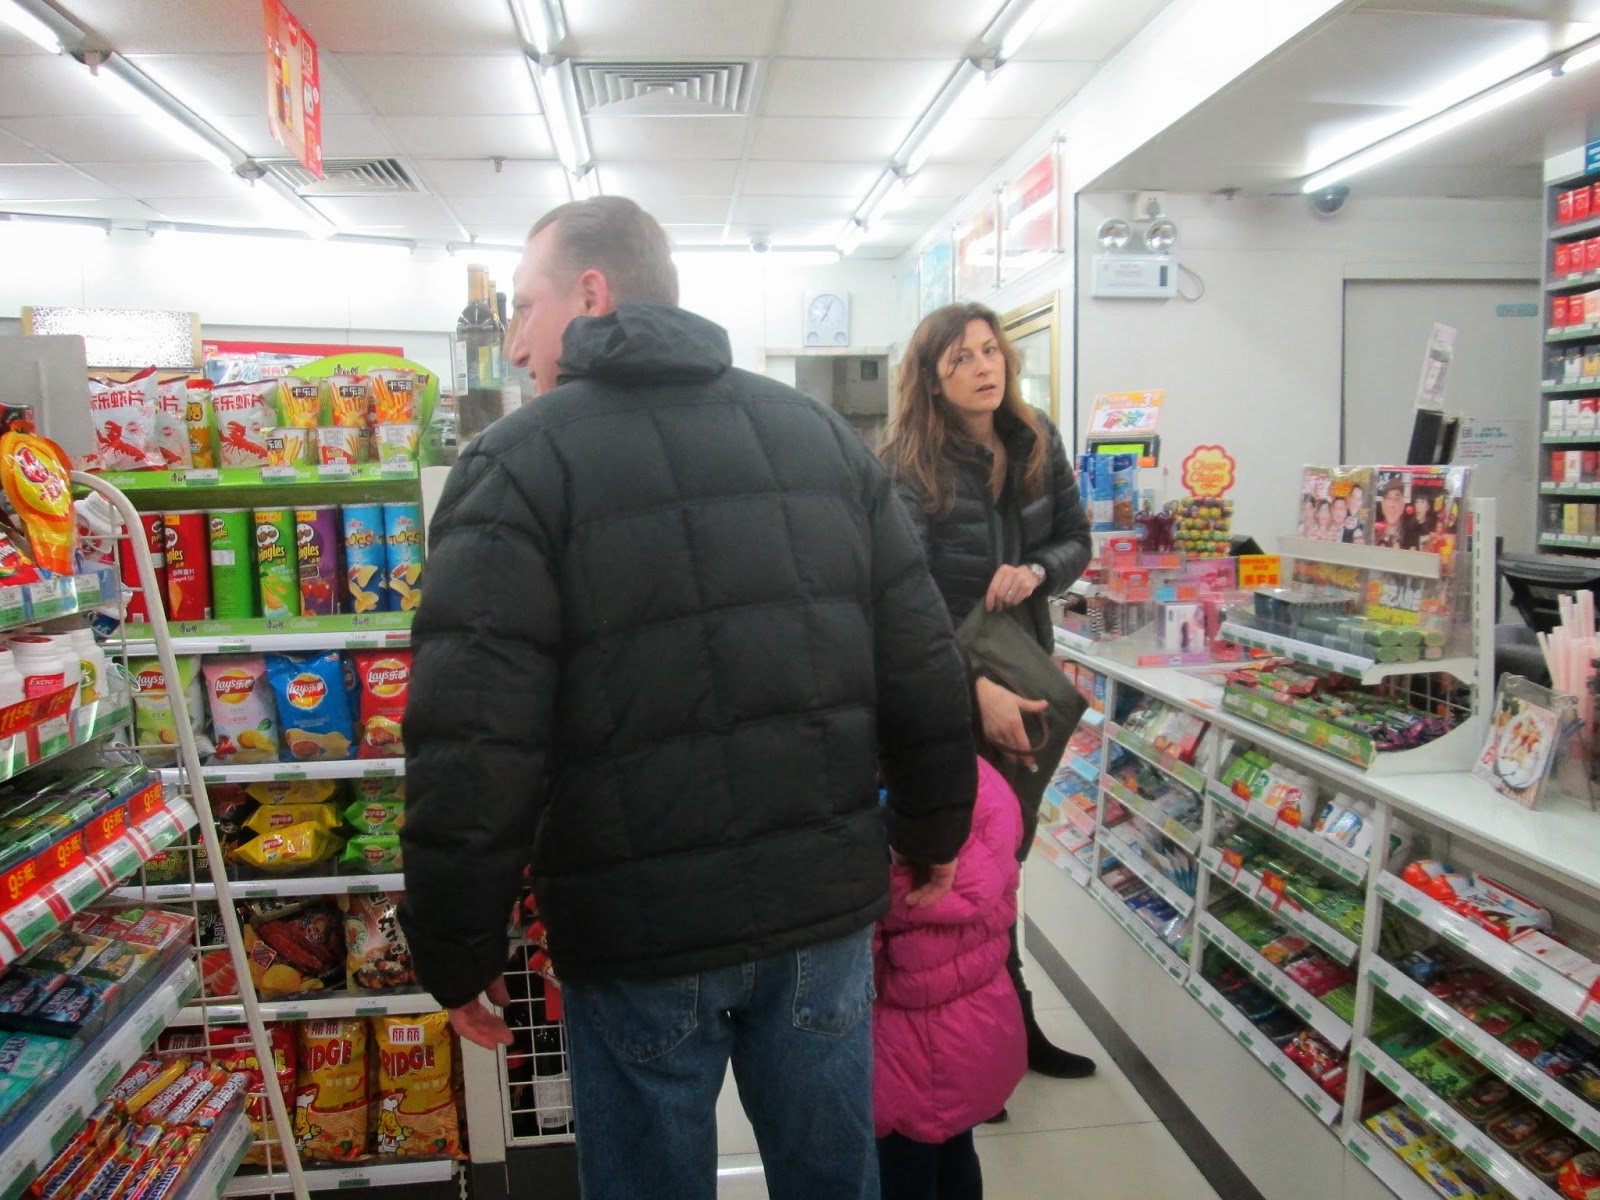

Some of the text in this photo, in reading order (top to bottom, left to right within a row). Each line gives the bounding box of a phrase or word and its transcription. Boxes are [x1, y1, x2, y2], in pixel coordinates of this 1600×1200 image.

[138, 675, 158, 688] Lay's
[368, 671, 388, 685] Lay's
[215, 679, 235, 693] Lay's
